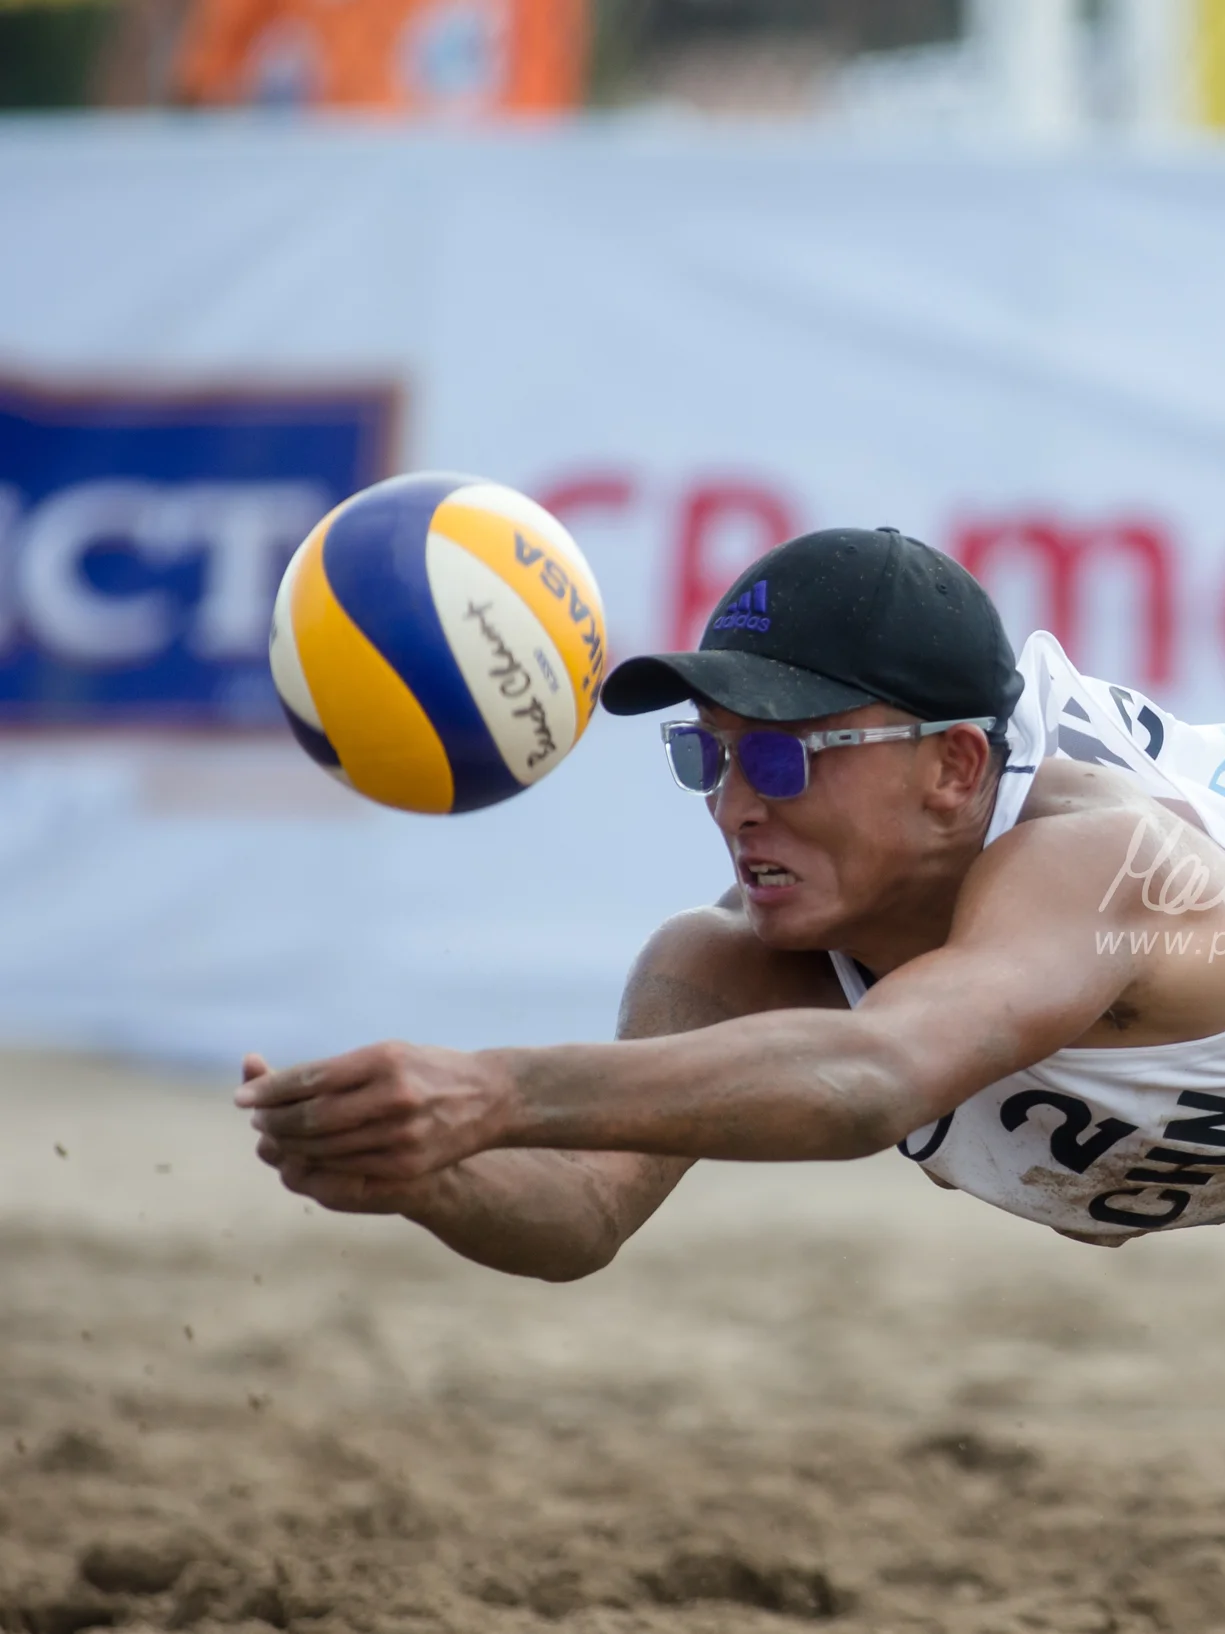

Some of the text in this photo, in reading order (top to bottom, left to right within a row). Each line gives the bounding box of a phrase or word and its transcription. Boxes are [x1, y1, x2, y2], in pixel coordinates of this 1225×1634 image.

[0, 480, 318, 662] CT
[713, 611, 771, 633] adidas
[1000, 1089, 1139, 1174] 2
